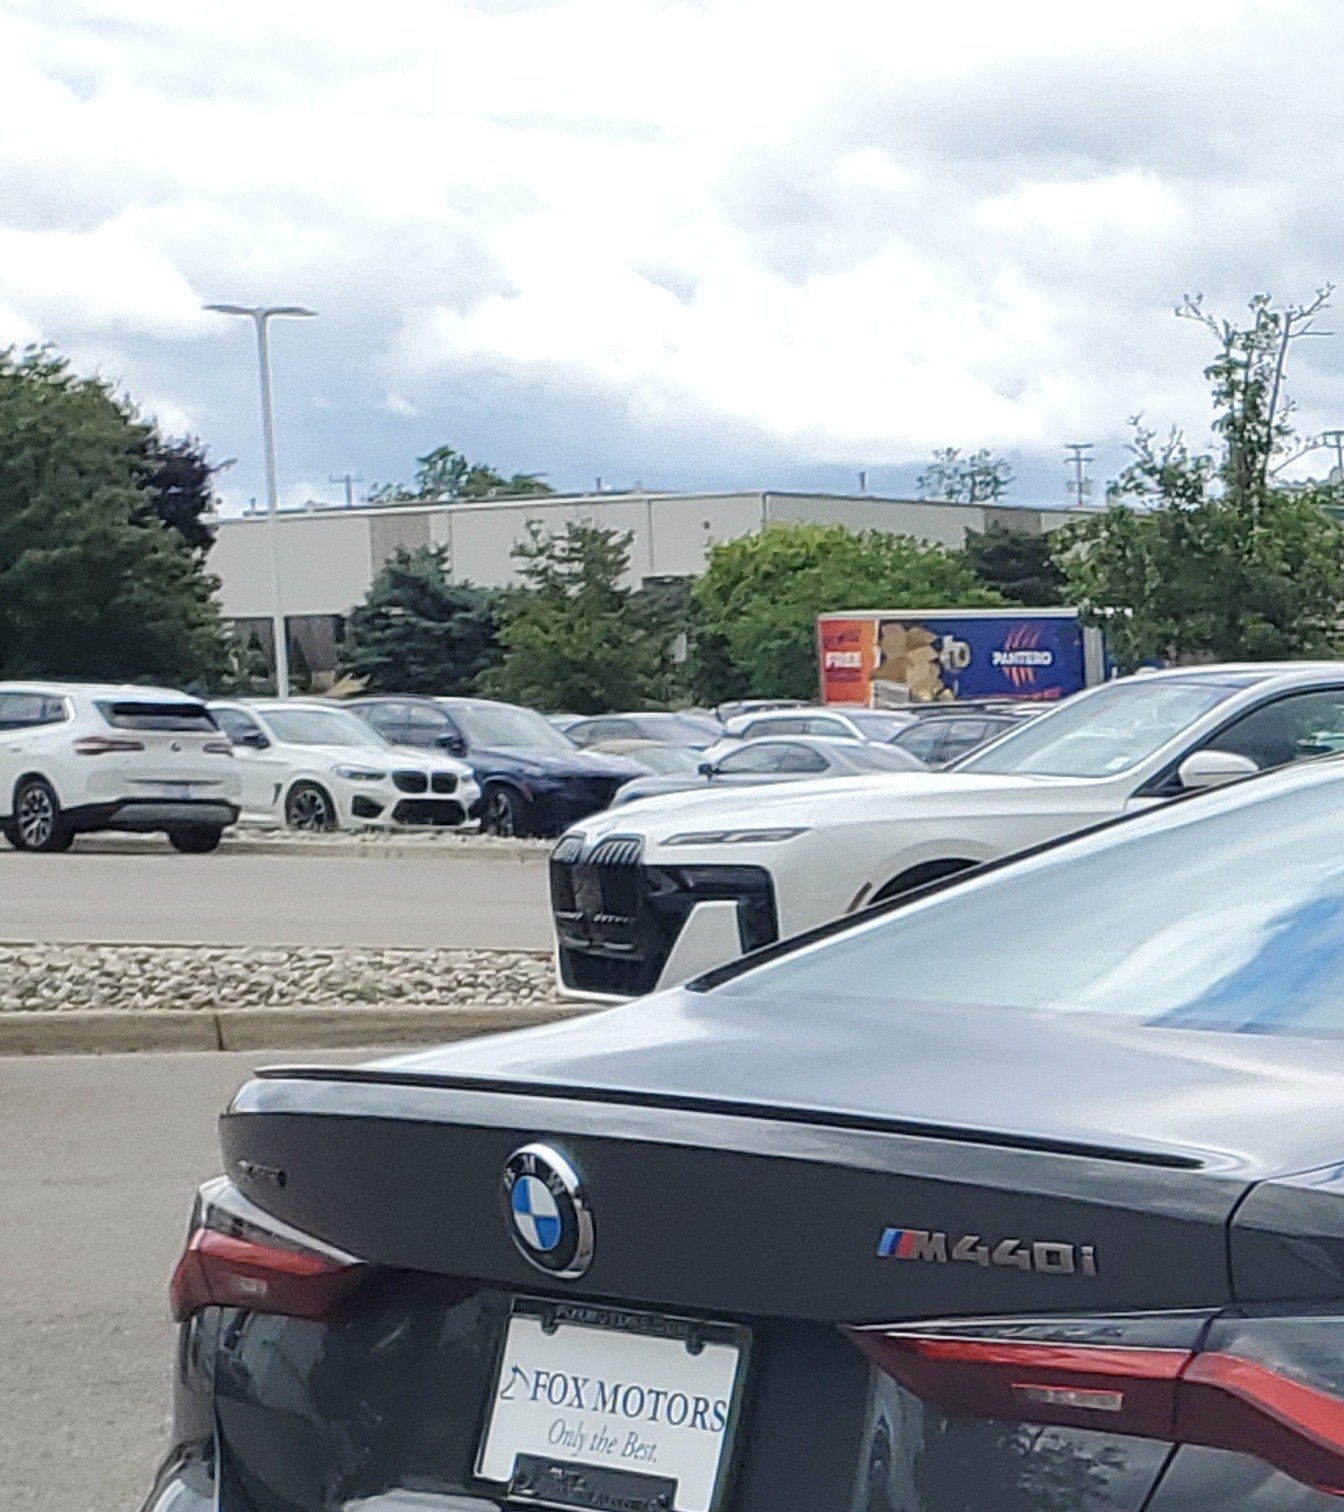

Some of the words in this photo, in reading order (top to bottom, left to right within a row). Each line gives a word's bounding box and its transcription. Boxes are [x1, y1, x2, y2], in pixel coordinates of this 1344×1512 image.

[503, 1155, 566, 1196] BMW
[877, 1227, 1097, 1276] M440i
[530, 1370, 590, 1409] FOX
[592, 1381, 728, 1433] MOTORS
[548, 1418, 587, 1457] Only
[590, 1426, 618, 1455] the
